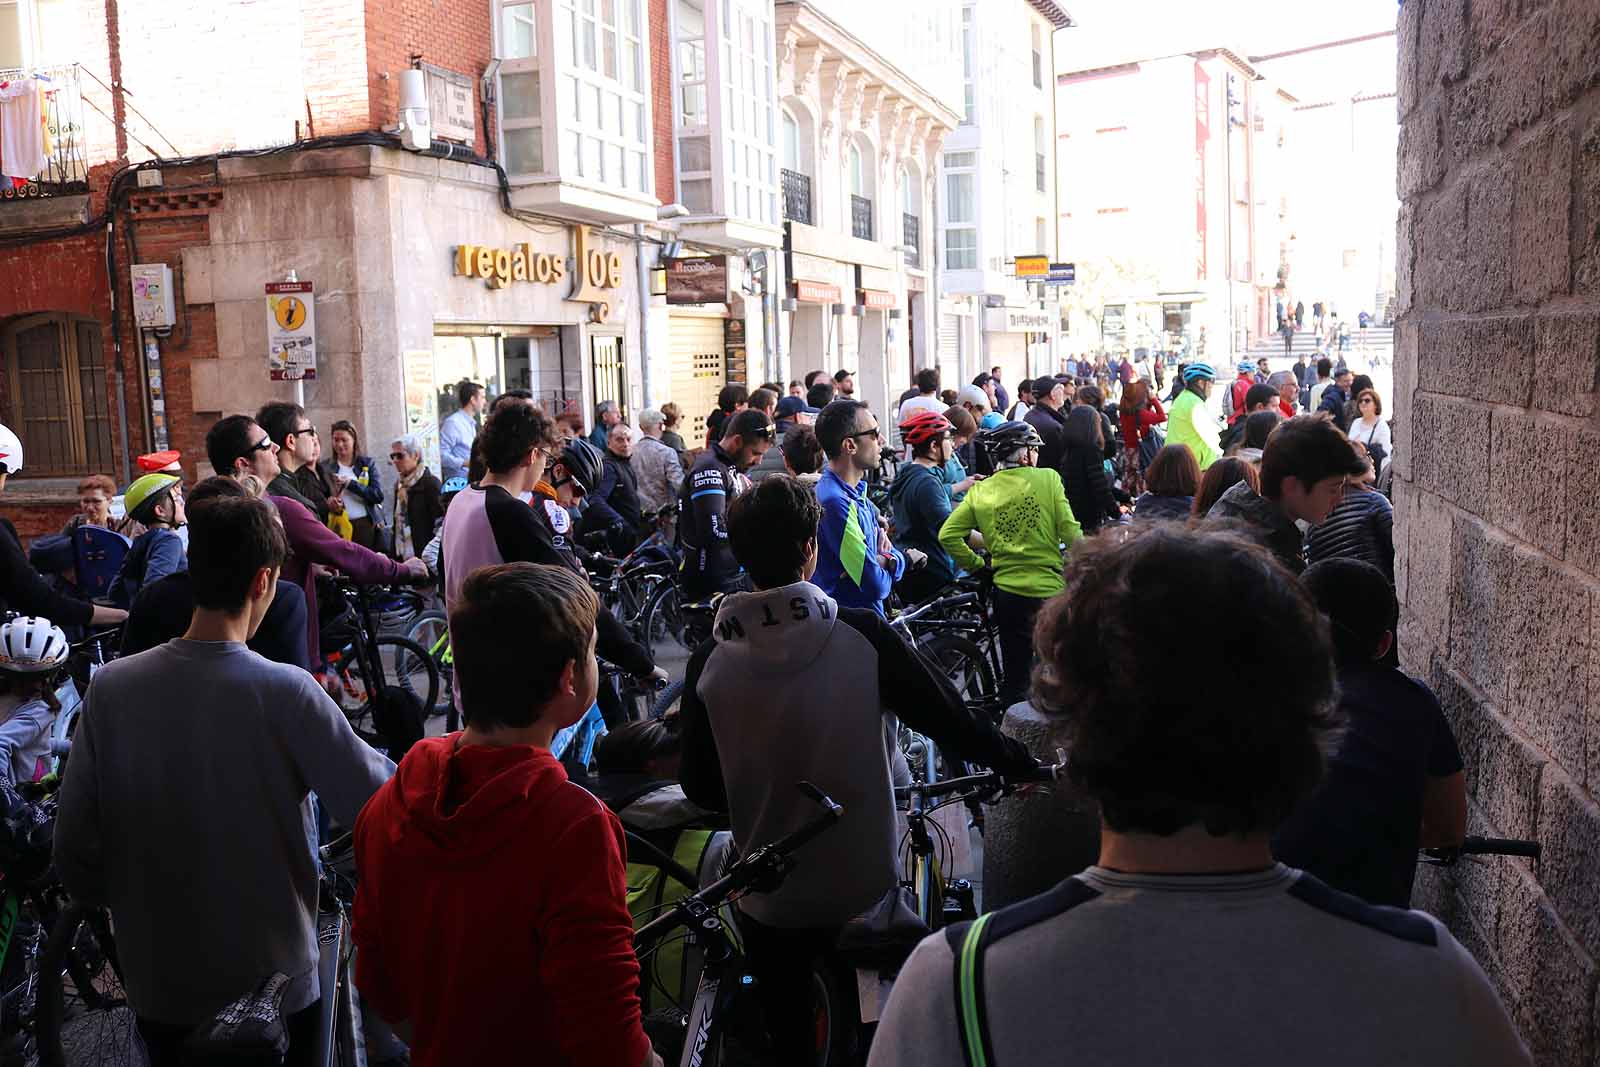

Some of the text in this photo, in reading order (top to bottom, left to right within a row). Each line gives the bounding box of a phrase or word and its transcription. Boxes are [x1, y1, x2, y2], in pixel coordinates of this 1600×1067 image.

[457, 225, 622, 322] regalos Joe
[694, 470, 722, 480] BLACK
[694, 478, 723, 488] EDITION
